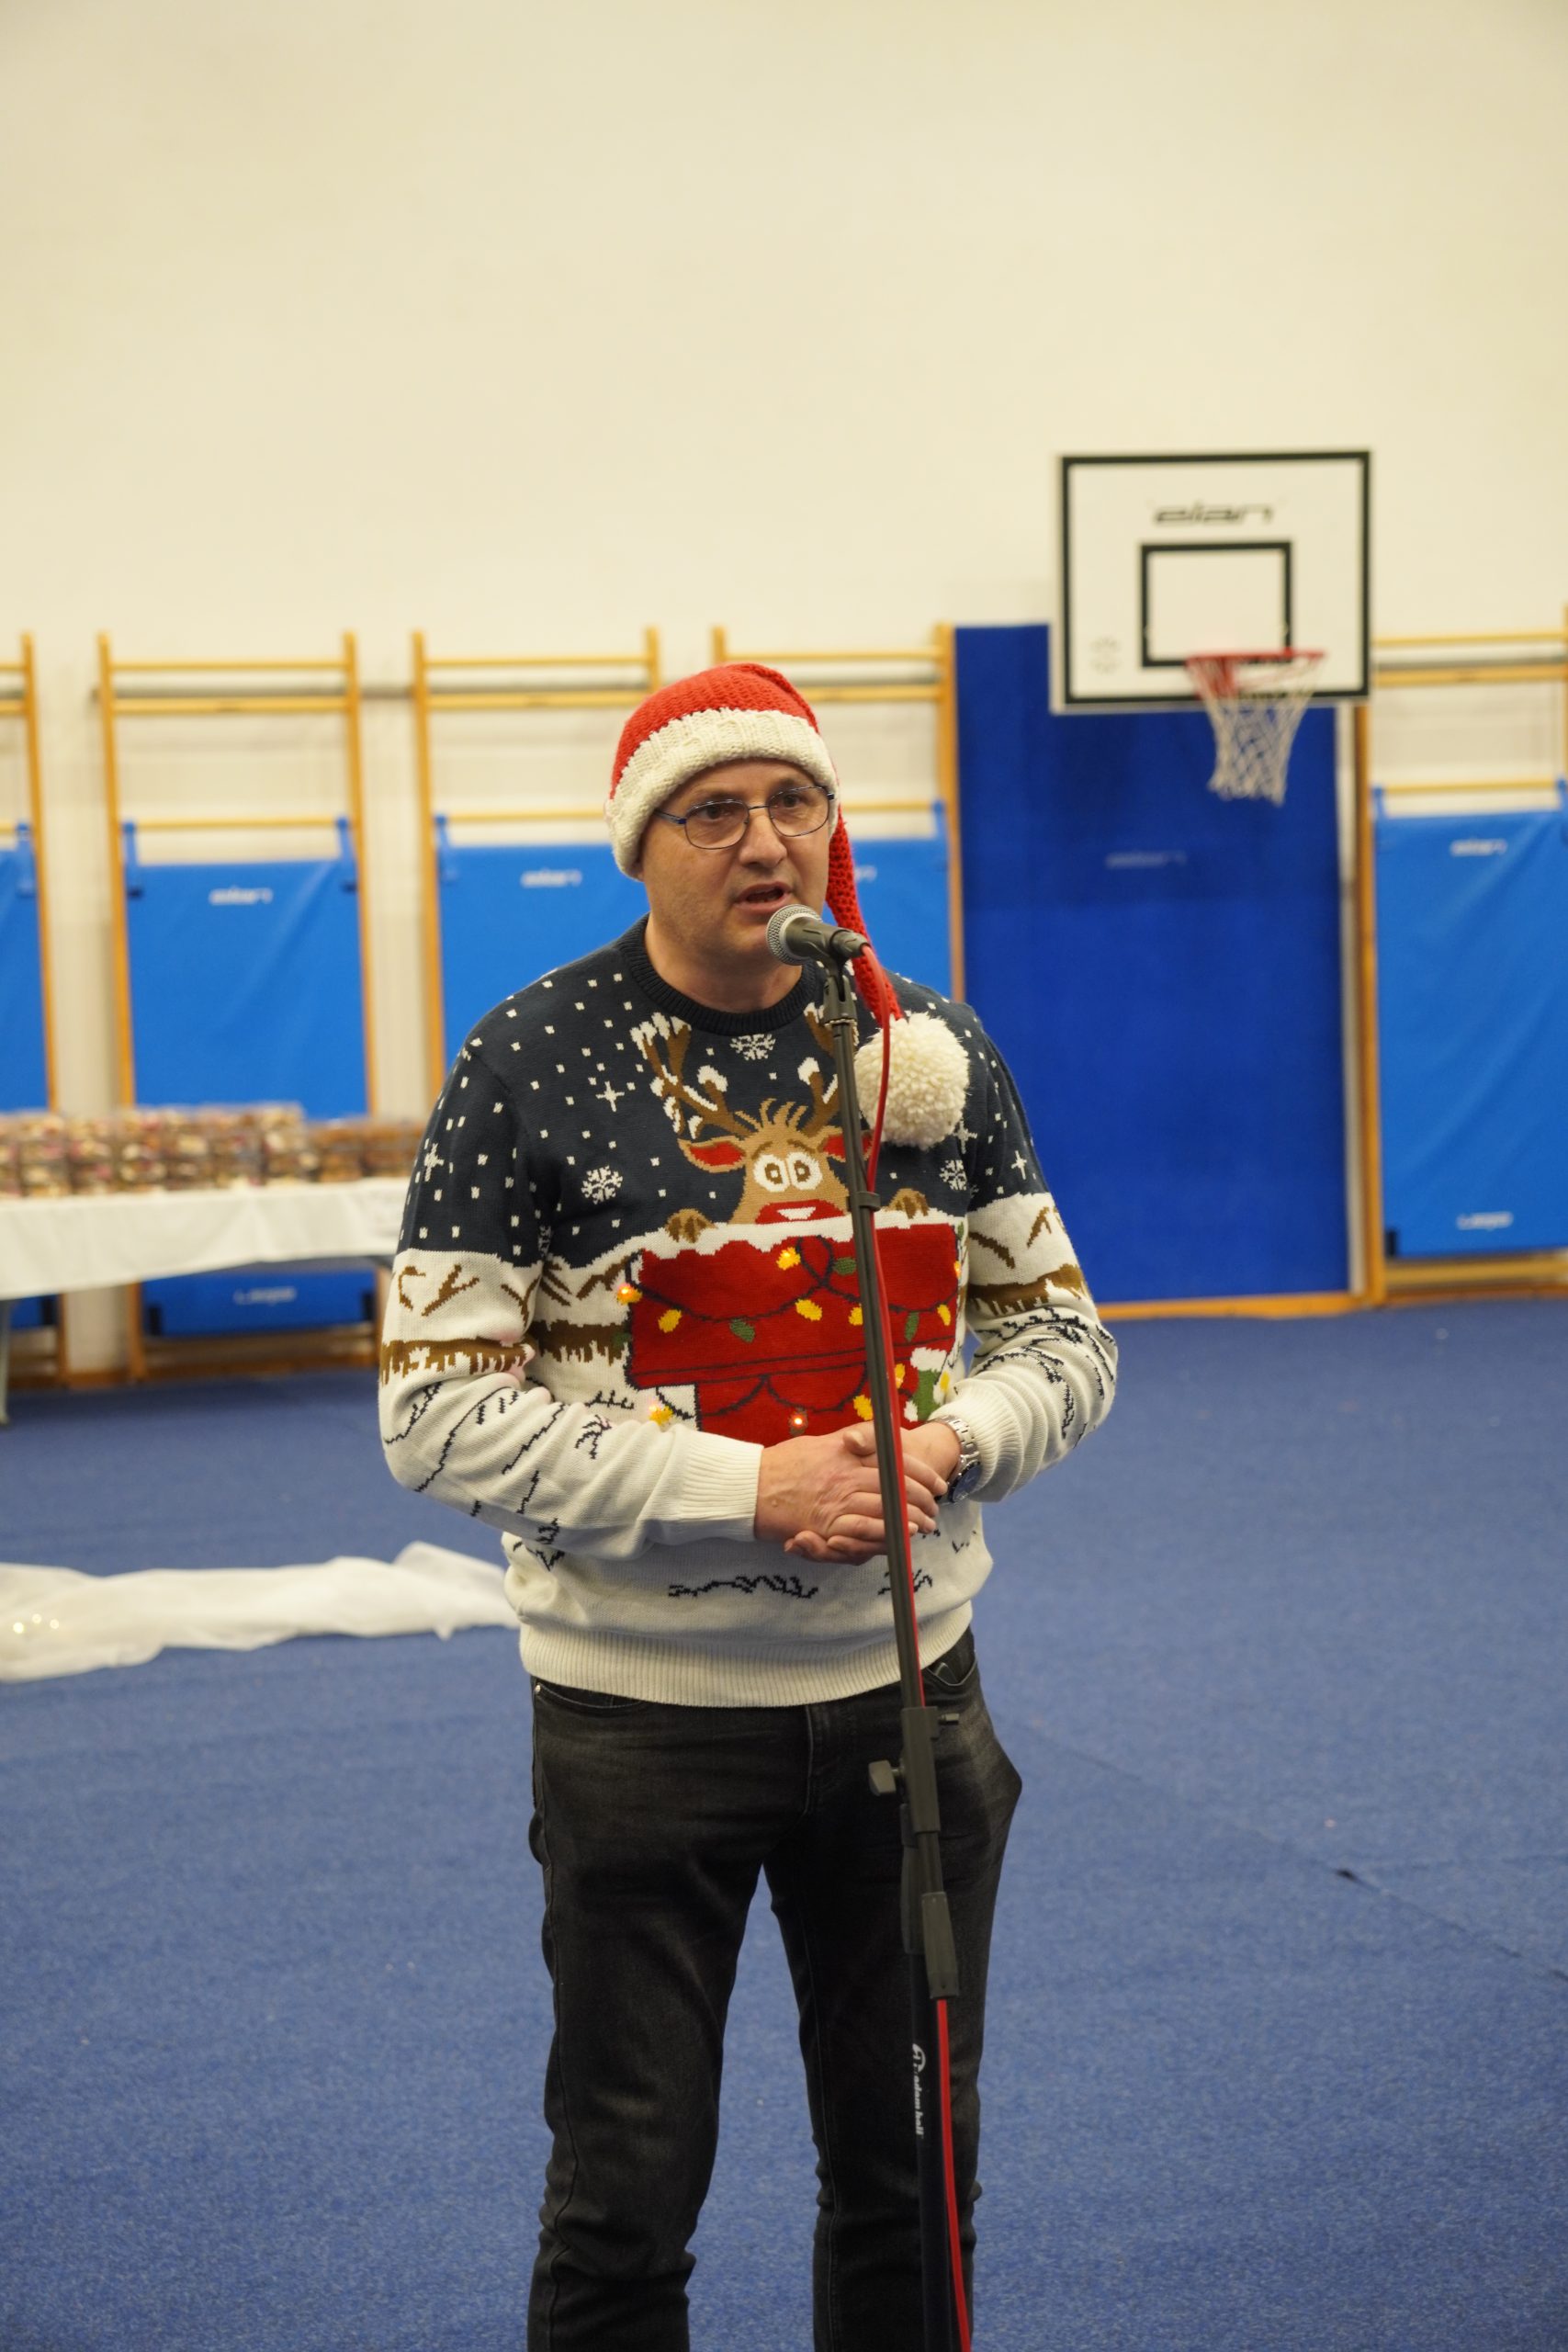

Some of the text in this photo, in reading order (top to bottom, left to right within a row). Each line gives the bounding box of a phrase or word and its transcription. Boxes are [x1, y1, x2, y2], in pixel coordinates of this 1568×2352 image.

[1155, 503, 1273, 526] elan
[914, 2075, 924, 2135] adam hall
